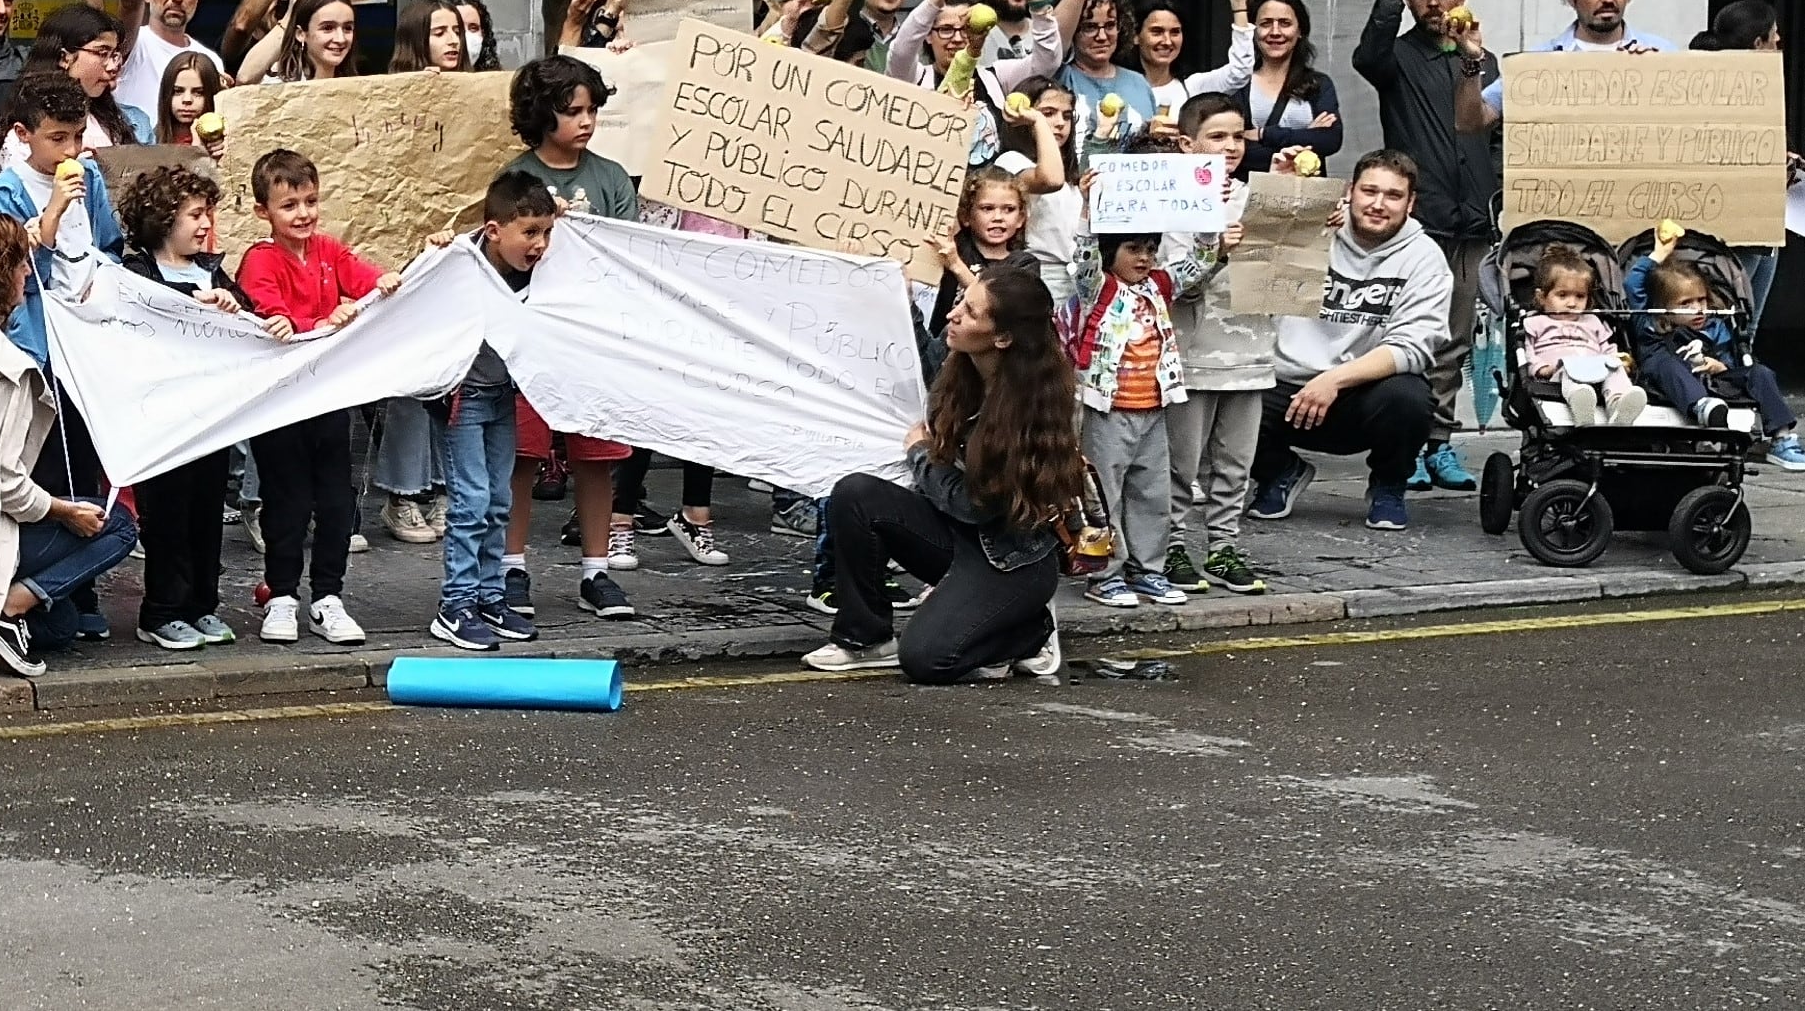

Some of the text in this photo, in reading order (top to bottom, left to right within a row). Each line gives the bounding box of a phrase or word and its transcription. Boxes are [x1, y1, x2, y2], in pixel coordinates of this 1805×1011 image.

[689, 33, 968, 145] POR UN COMEDOR
[1510, 69, 1770, 107] COMEDOR ESCOLAR
[672, 82, 965, 198] ESCOLAR SALUDABLE
[1507, 121, 1778, 167] SALUDABLE Y PÚBLICO
[666, 124, 956, 238] Y PÚBLICO DURANTE
[1097, 159, 1168, 173] COMEDOR
[1116, 178, 1177, 192] ESCOLAR
[663, 160, 751, 214] TODO
[762, 194, 798, 233] EL
[1158, 197, 1213, 212] TODAS
[1511, 178, 1725, 223] TODO EL CURSO
[704, 246, 893, 290] COMEDOR
